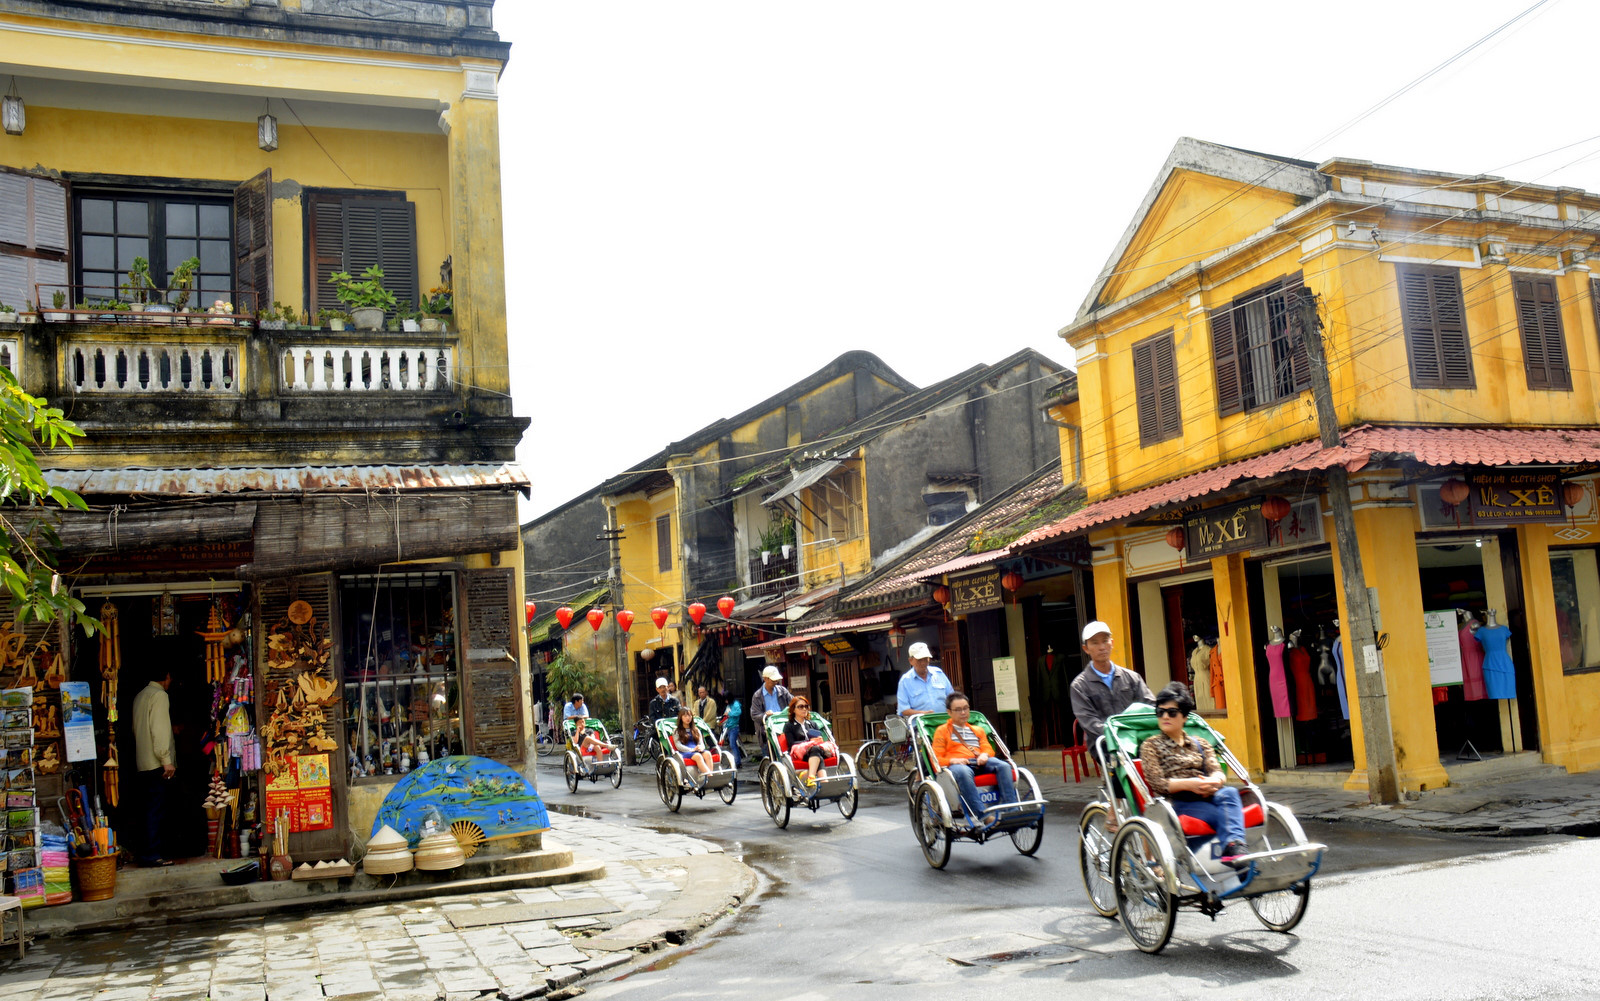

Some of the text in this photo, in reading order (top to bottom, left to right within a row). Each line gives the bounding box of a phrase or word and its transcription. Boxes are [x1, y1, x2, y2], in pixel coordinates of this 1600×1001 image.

[1510, 474, 1535, 483] CLOTH
[1536, 474, 1557, 483] SHOP
[1508, 484, 1555, 507] XÊ
[1214, 511, 1248, 544] XÊ
[971, 575, 987, 585] CLOTH
[969, 581, 995, 601] XÊ
[981, 792, 998, 803] 001
